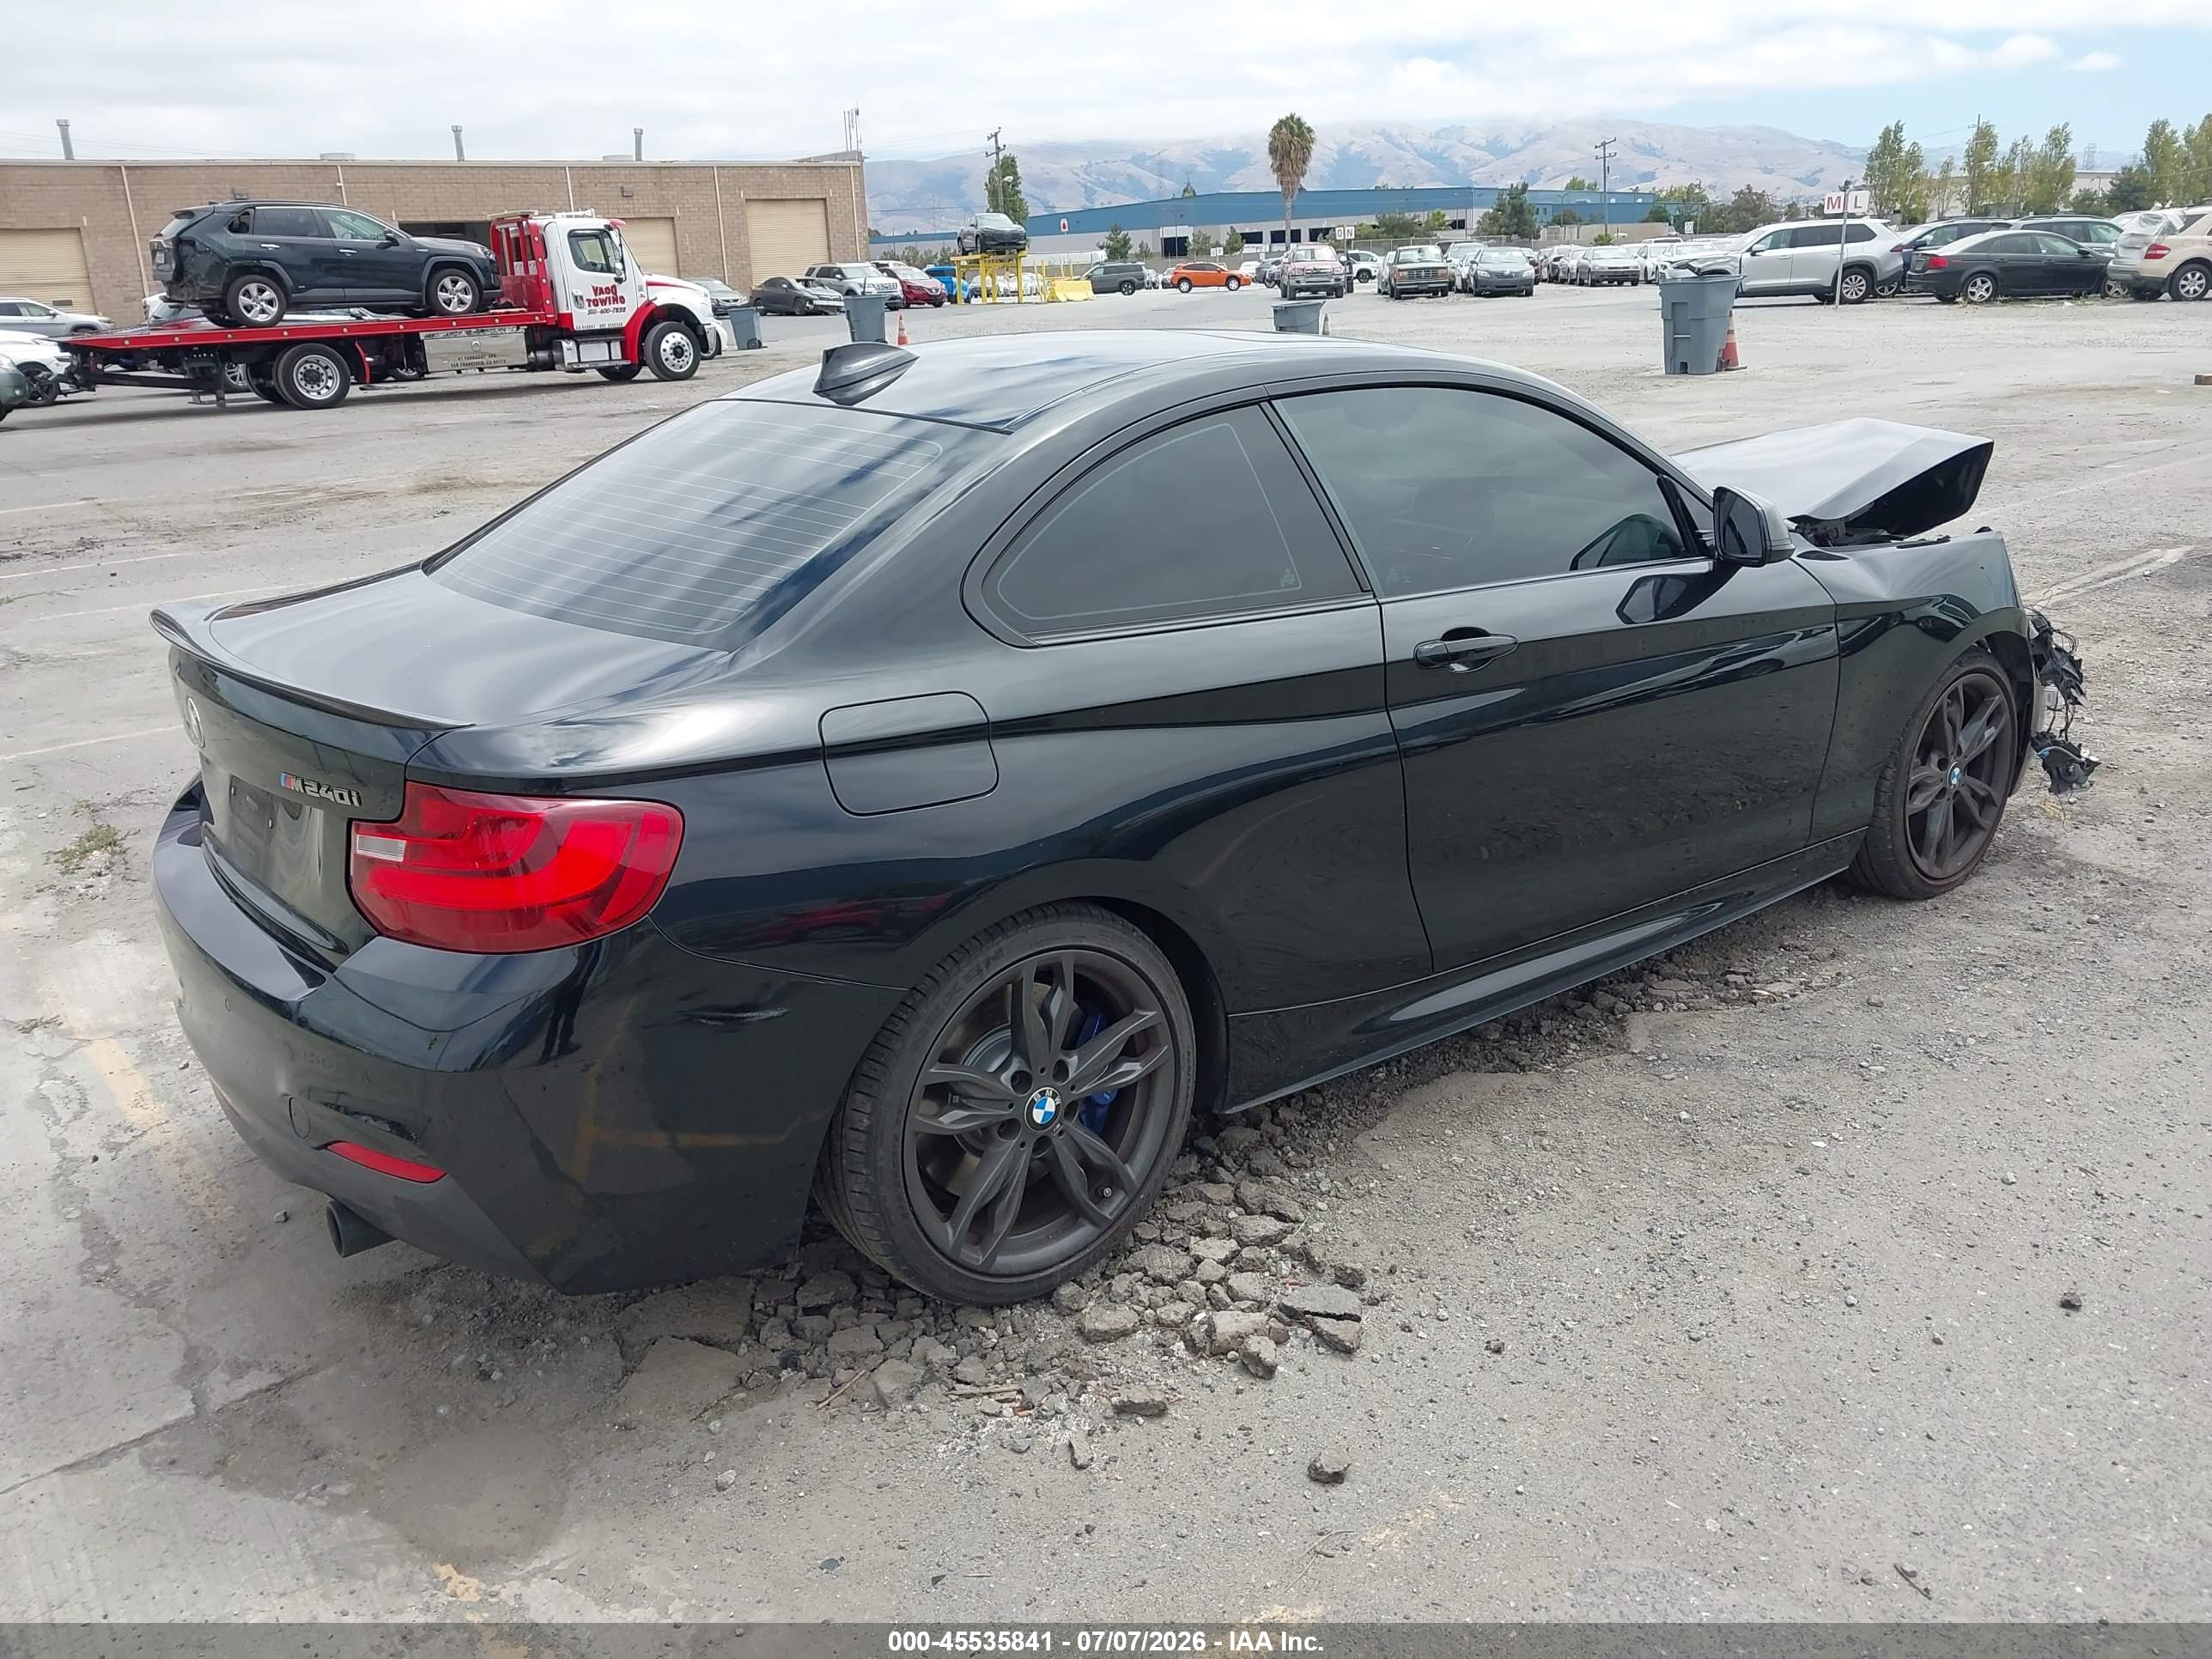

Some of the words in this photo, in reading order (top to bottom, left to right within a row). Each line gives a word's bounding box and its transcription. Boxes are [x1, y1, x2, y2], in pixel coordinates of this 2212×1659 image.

[1826, 196, 1842, 210] M
[1854, 195, 1863, 209] L
[586, 295, 626, 307] TOWING
[291, 776, 362, 807] M240i
[1033, 1089, 1061, 1106] BMW
